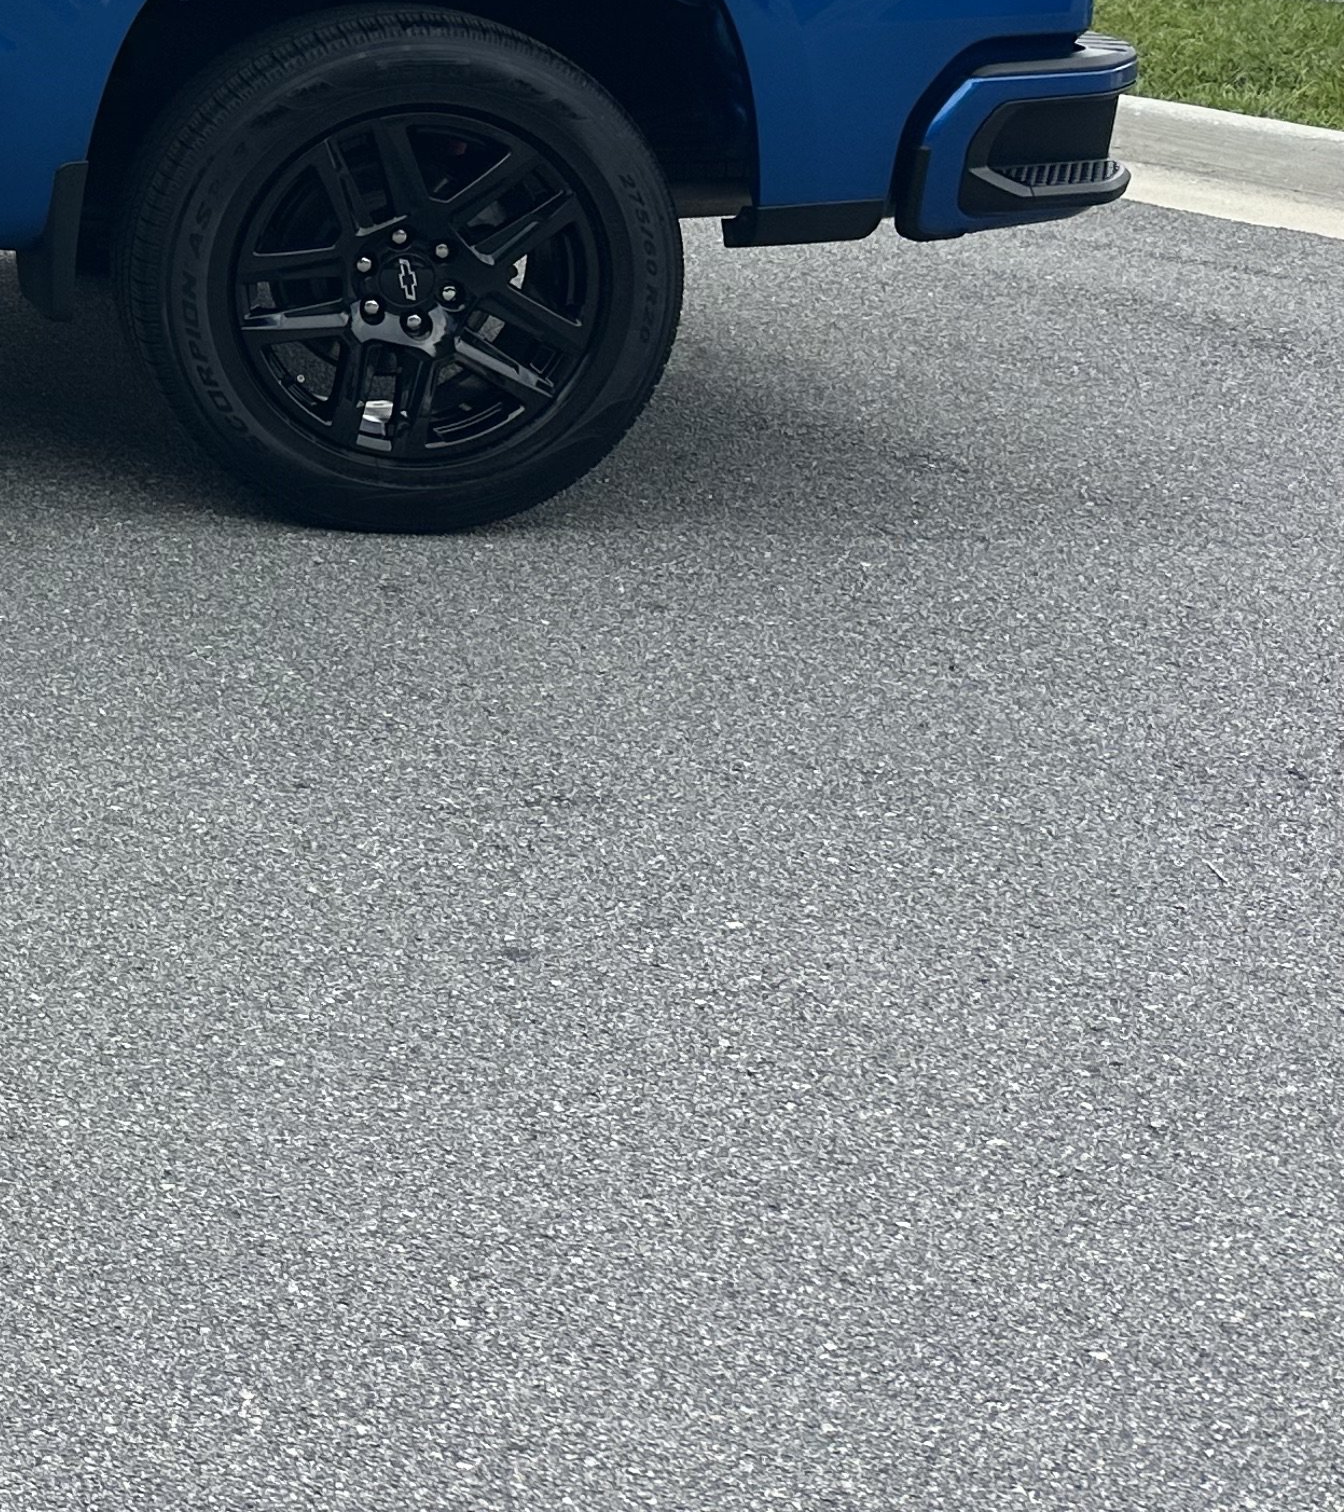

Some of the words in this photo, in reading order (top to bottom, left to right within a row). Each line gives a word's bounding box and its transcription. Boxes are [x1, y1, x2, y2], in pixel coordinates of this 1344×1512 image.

[189, 201, 211, 258] AS
[618, 173, 658, 276] 275/60
[639, 283, 658, 343] R20
[182, 271, 268, 450] SCORPION
